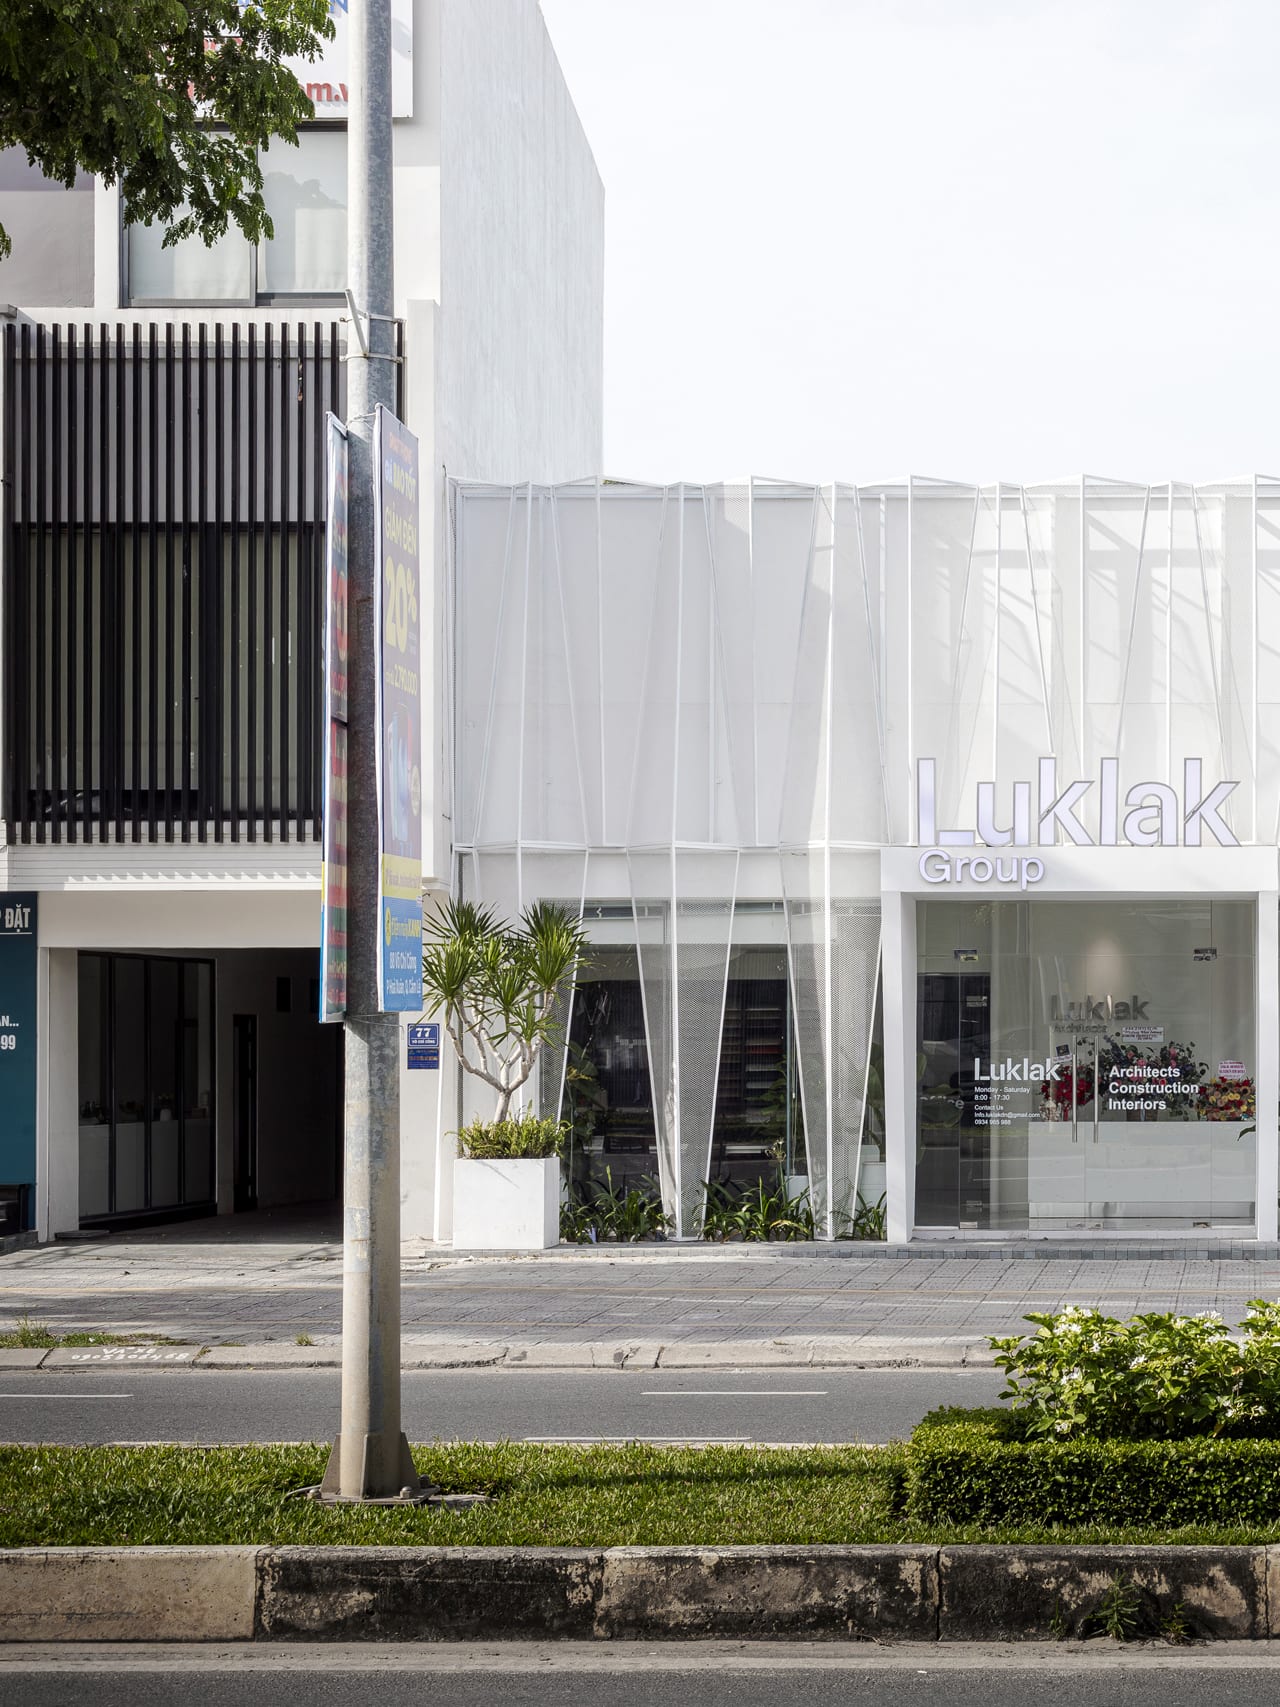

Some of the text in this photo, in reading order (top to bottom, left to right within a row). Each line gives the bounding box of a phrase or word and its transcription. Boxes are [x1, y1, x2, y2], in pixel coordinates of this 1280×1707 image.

[385, 555, 417, 654] 20%
[916, 757, 1242, 847] Luklak
[918, 848, 1046, 892] Group
[5, 903, 31, 933] ĐẶT
[0, 1015, 19, 1027] N...
[415, 1027, 432, 1038] 77
[0, 1034, 16, 1050] 99
[974, 1057, 1061, 1081] Luklak
[1109, 1065, 1181, 1078] Architects
[1108, 1081, 1199, 1094] Construction
[1108, 1097, 1167, 1110] Interiors
